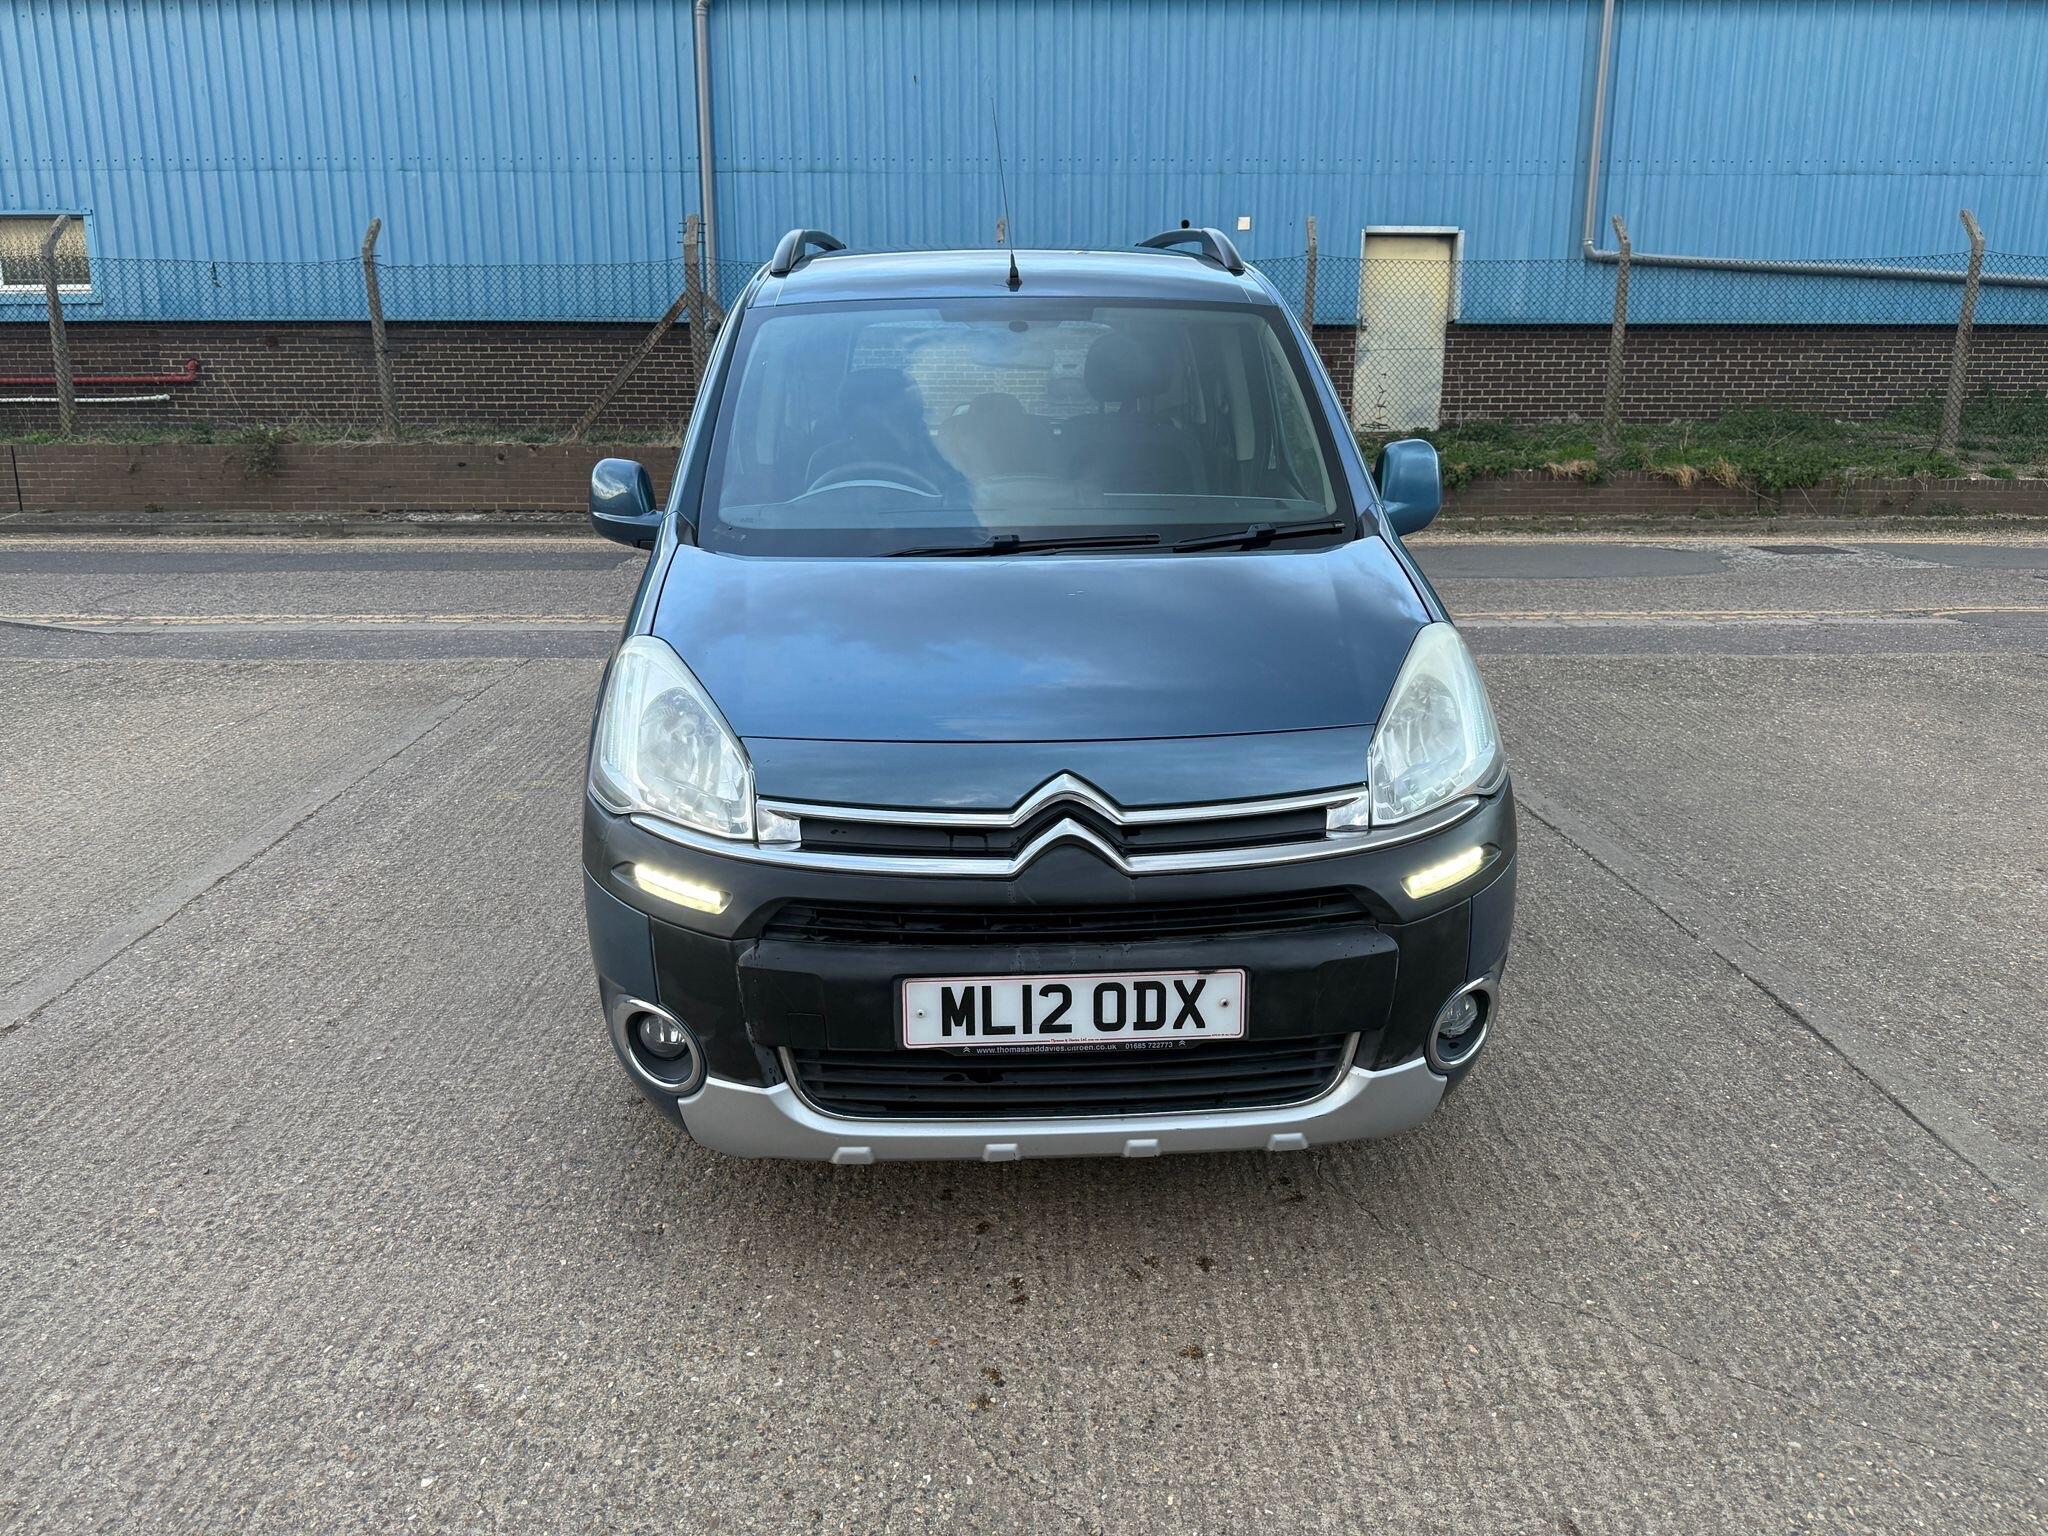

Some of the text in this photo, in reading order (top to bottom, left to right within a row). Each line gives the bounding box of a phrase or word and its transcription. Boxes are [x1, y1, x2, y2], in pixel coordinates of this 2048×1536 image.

[941, 979, 1207, 1036] ML12 ODX
[976, 1041, 1173, 1054] www.thomasanddavies.citroen.co.uk 01685 722773
